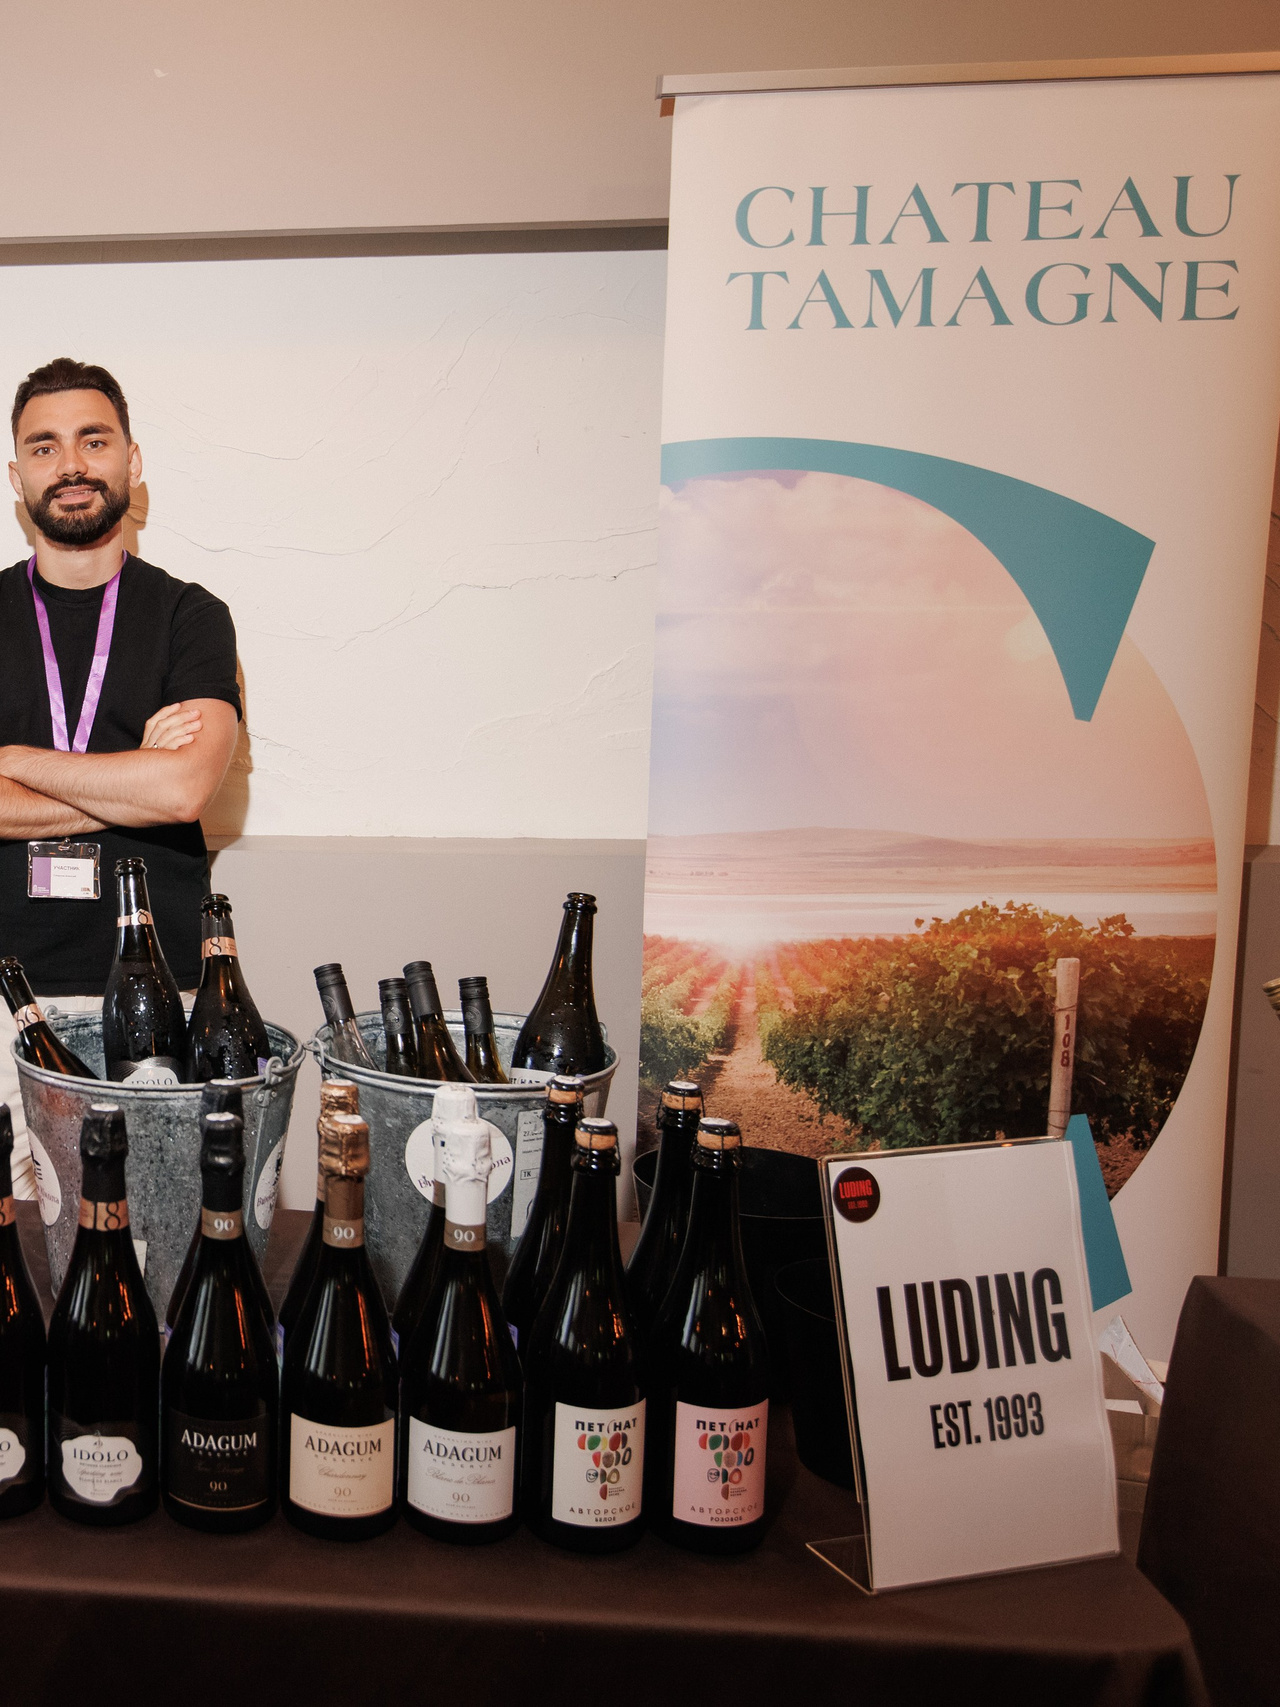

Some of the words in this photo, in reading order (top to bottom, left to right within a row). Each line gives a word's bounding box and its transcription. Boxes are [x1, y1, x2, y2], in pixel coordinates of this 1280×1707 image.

[735, 173, 1242, 249] CHATEAU
[725, 259, 1241, 331] TAMAGNE
[838, 1179, 873, 1199] LUDING
[214, 1218, 234, 1233] 90
[333, 1226, 355, 1240] 90
[454, 1229, 476, 1243] 90
[875, 1267, 1072, 1382] LUDING
[929, 1399, 982, 1449] EST.
[983, 1391, 1045, 1442] 1993
[181, 1428, 257, 1451] ADAGUM
[304, 1435, 382, 1457] ADAGUM
[73, 1448, 128, 1462] IDOLO
[423, 1439, 502, 1462] ADAGUM
[314, 1453, 373, 1463] RESERVE
[433, 1458, 492, 1469] RESERVE
[209, 1480, 228, 1492] 90
[333, 1486, 352, 1498] 90
[451, 1491, 471, 1503] 90
[569, 1502, 636, 1515] АВТОРСКОЕ
[690, 1501, 759, 1515] АВТОРСКОЕ
